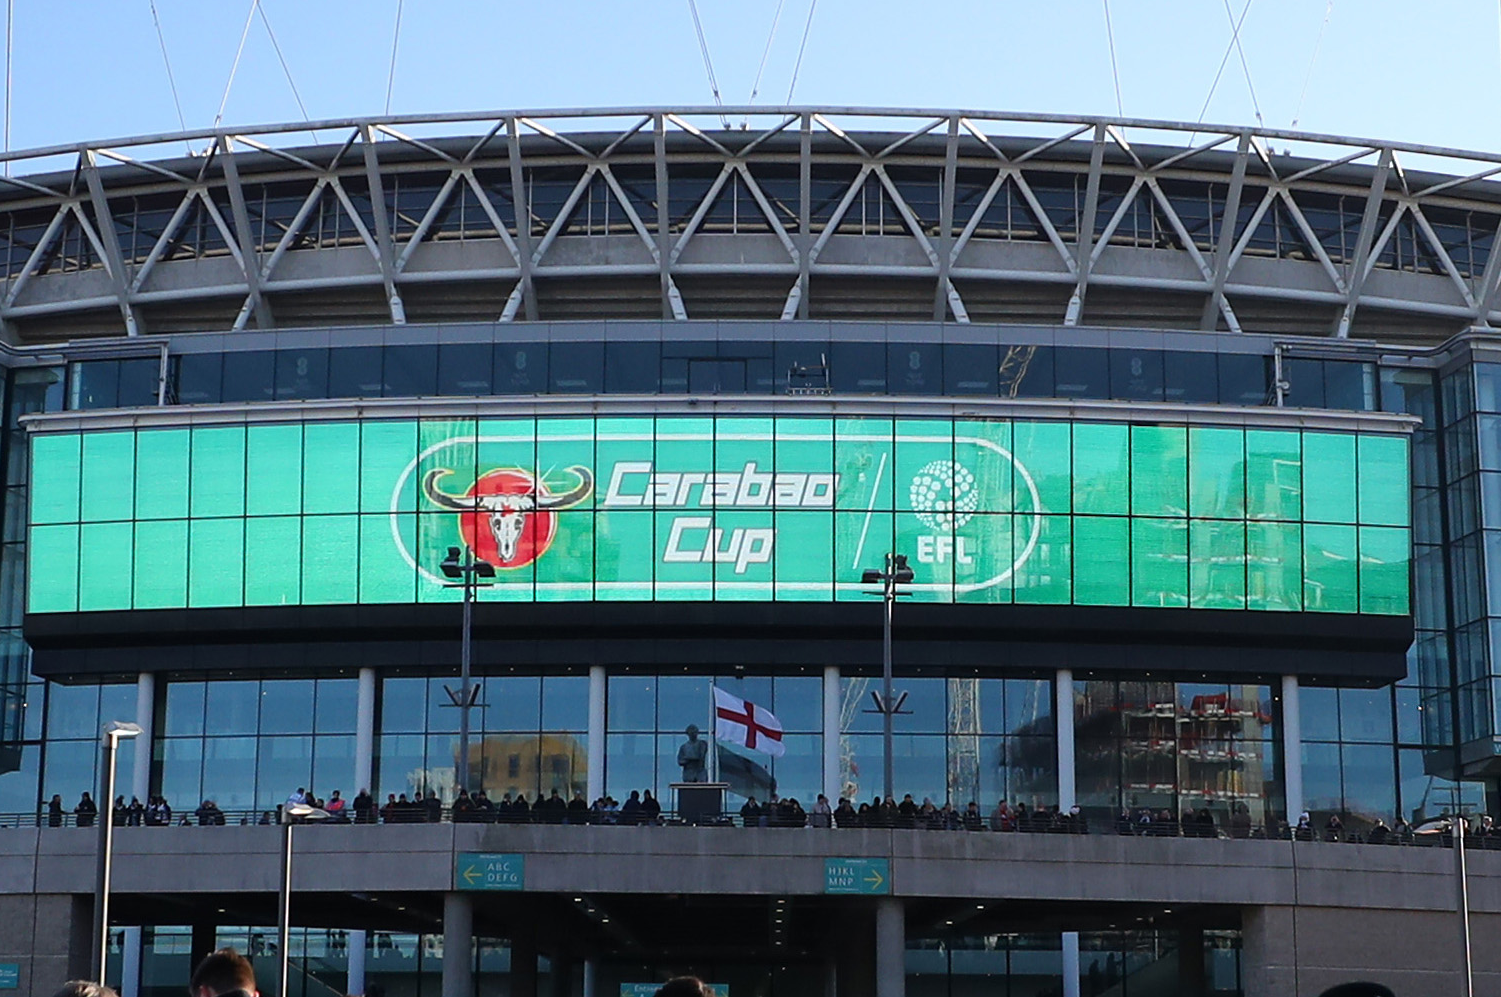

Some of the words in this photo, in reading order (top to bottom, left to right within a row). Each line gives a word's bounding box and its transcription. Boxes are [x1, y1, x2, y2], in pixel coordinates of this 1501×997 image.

[603, 461, 840, 507] Carabao
[662, 516, 778, 574] Cup
[917, 536, 973, 564] EFL
[488, 863, 510, 871] ABC
[488, 873, 518, 882] DEFG
[829, 877, 854, 886] MNP
